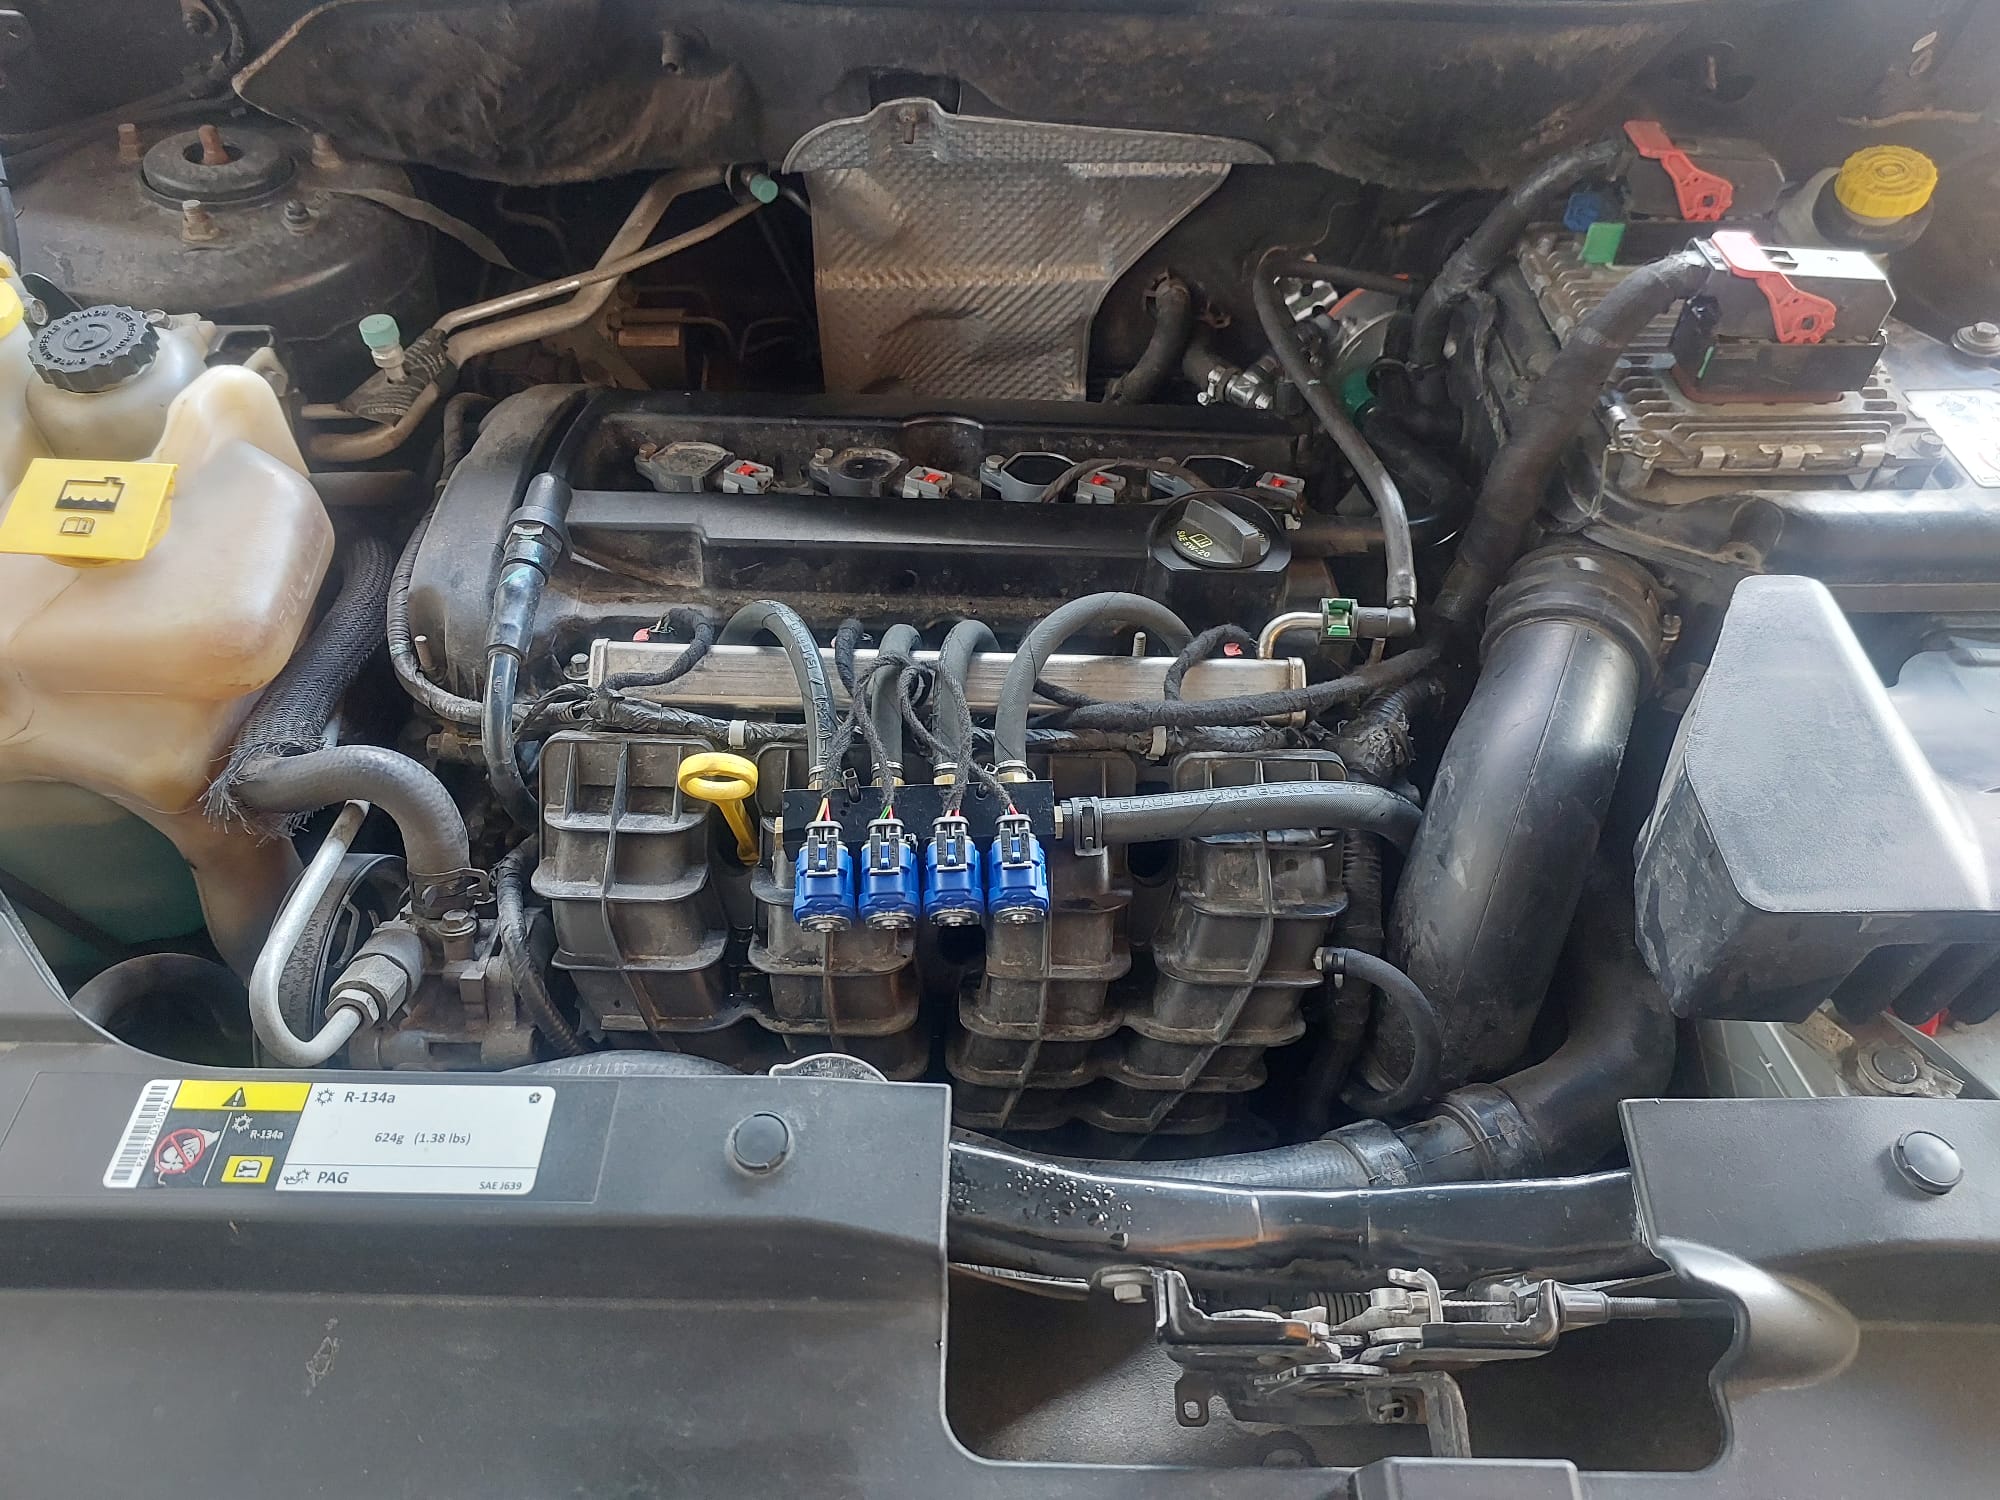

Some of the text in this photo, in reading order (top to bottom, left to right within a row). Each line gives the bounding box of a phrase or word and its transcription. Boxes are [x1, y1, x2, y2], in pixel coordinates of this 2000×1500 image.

[1183, 541, 1210, 558] 5W-20
[344, 1091, 396, 1104] R-134a
[250, 1129, 284, 1140] R-134a
[374, 1132, 471, 1146] 624g (1.38 lbs)
[317, 1171, 350, 1184] PAG
[479, 1181, 522, 1191] SAE J639
